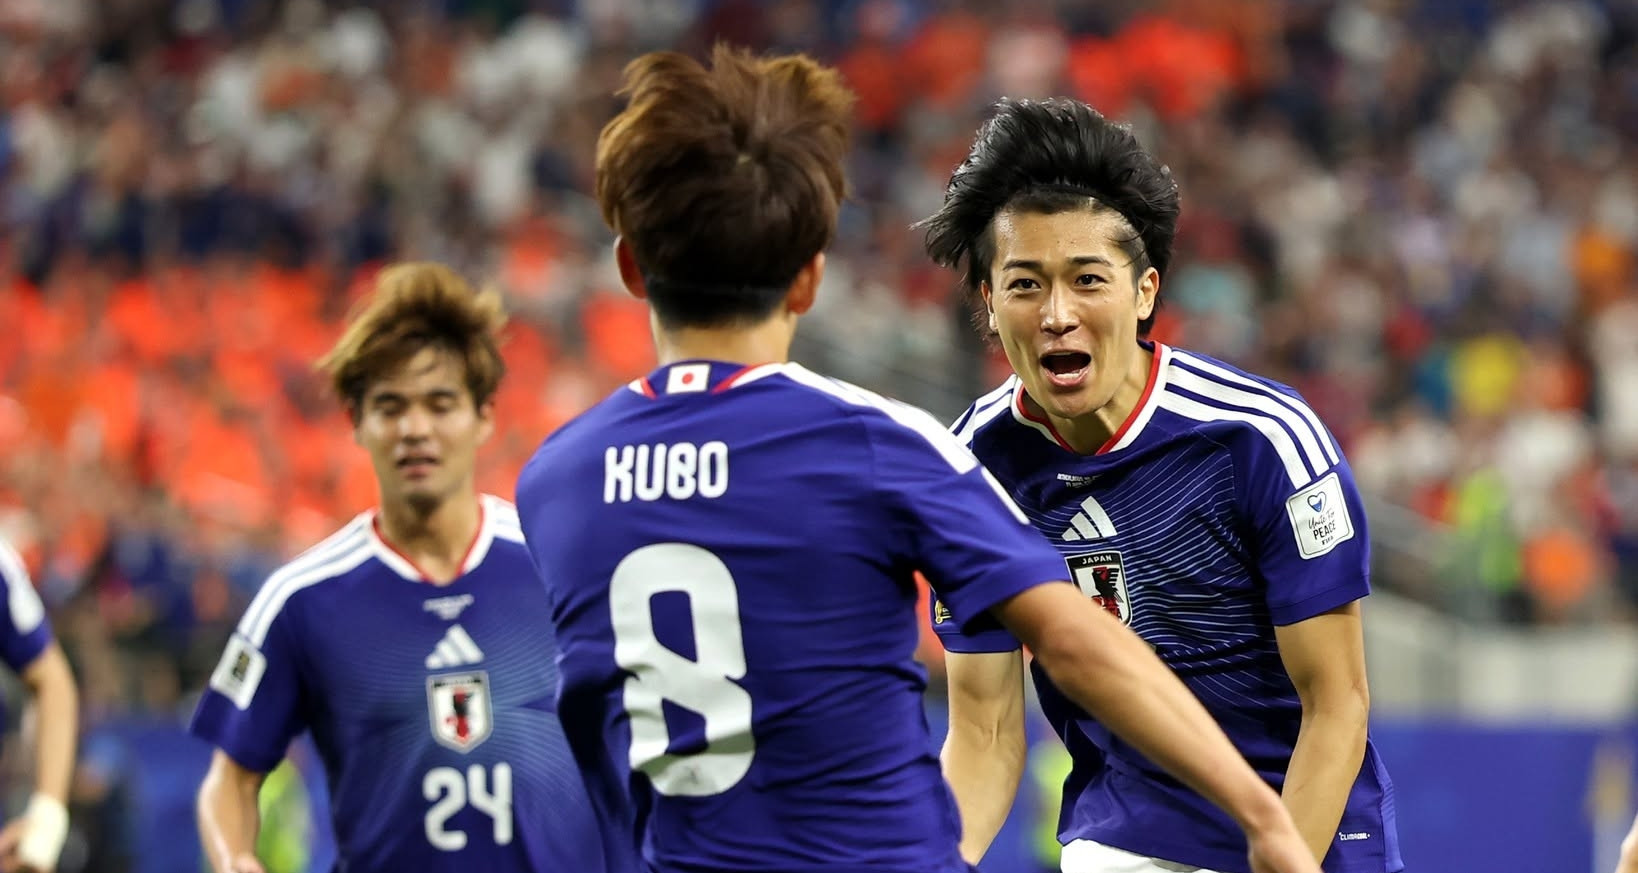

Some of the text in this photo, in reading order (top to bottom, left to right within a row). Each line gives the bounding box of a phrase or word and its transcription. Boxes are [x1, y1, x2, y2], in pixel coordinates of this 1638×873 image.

[604, 441, 728, 503] KUBO
[1082, 555, 1113, 565] JAPAN
[1312, 520, 1336, 540] PEACE
[609, 542, 755, 796] 8
[422, 762, 513, 851] 24
